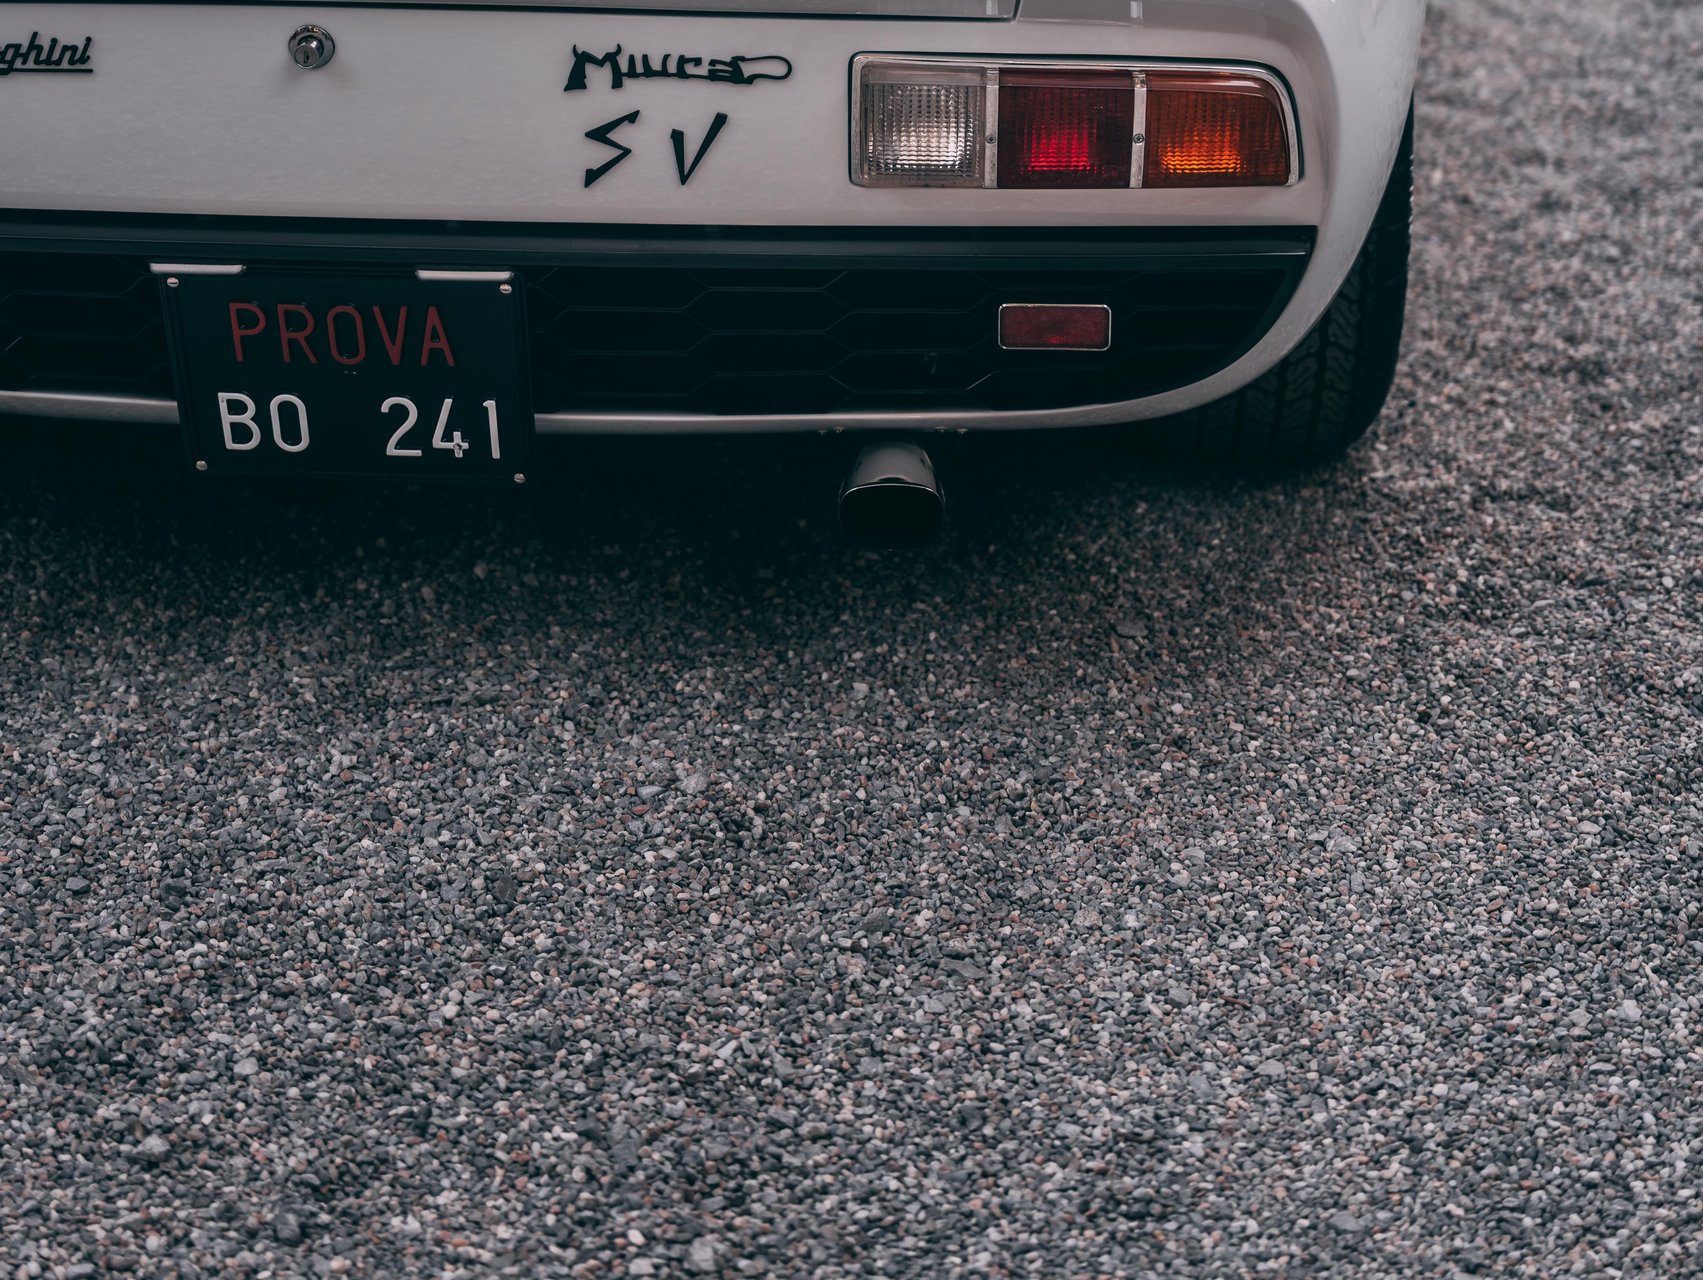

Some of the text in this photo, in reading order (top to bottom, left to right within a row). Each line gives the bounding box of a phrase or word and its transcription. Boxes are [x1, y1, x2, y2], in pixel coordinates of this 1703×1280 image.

[0, 31, 93, 75] ghini
[563, 43, 792, 91] Miura
[229, 302, 456, 367] PROVA
[218, 392, 501, 459] BO 241
